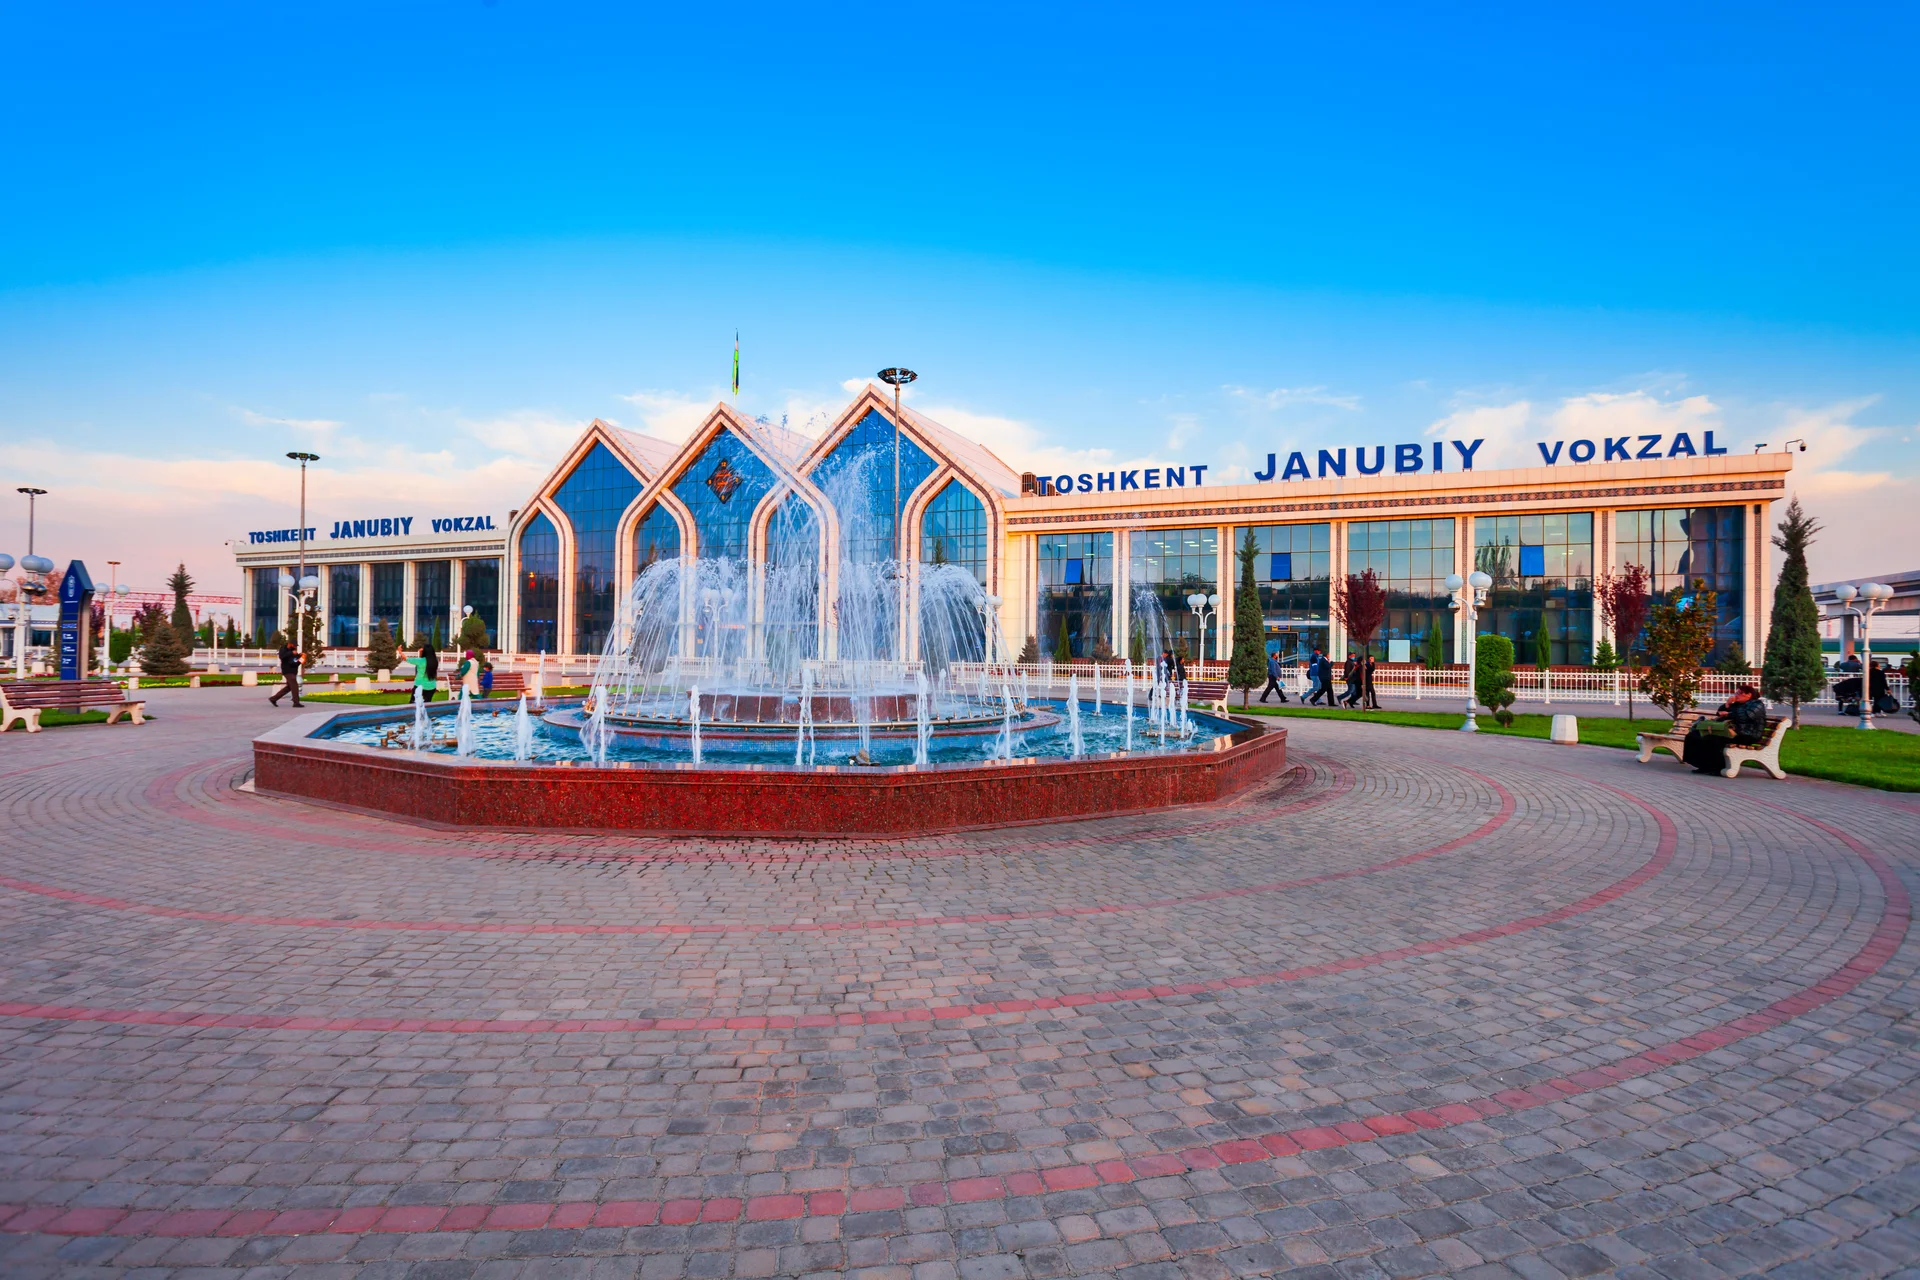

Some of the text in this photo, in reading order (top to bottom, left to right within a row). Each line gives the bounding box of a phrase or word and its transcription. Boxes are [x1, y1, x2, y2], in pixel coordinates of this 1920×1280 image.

[1036, 430, 1729, 495] TOSHKENT JANUBIY VOKZAL
[248, 515, 495, 544] TOSHKENT JANUBIY VOKZAL
